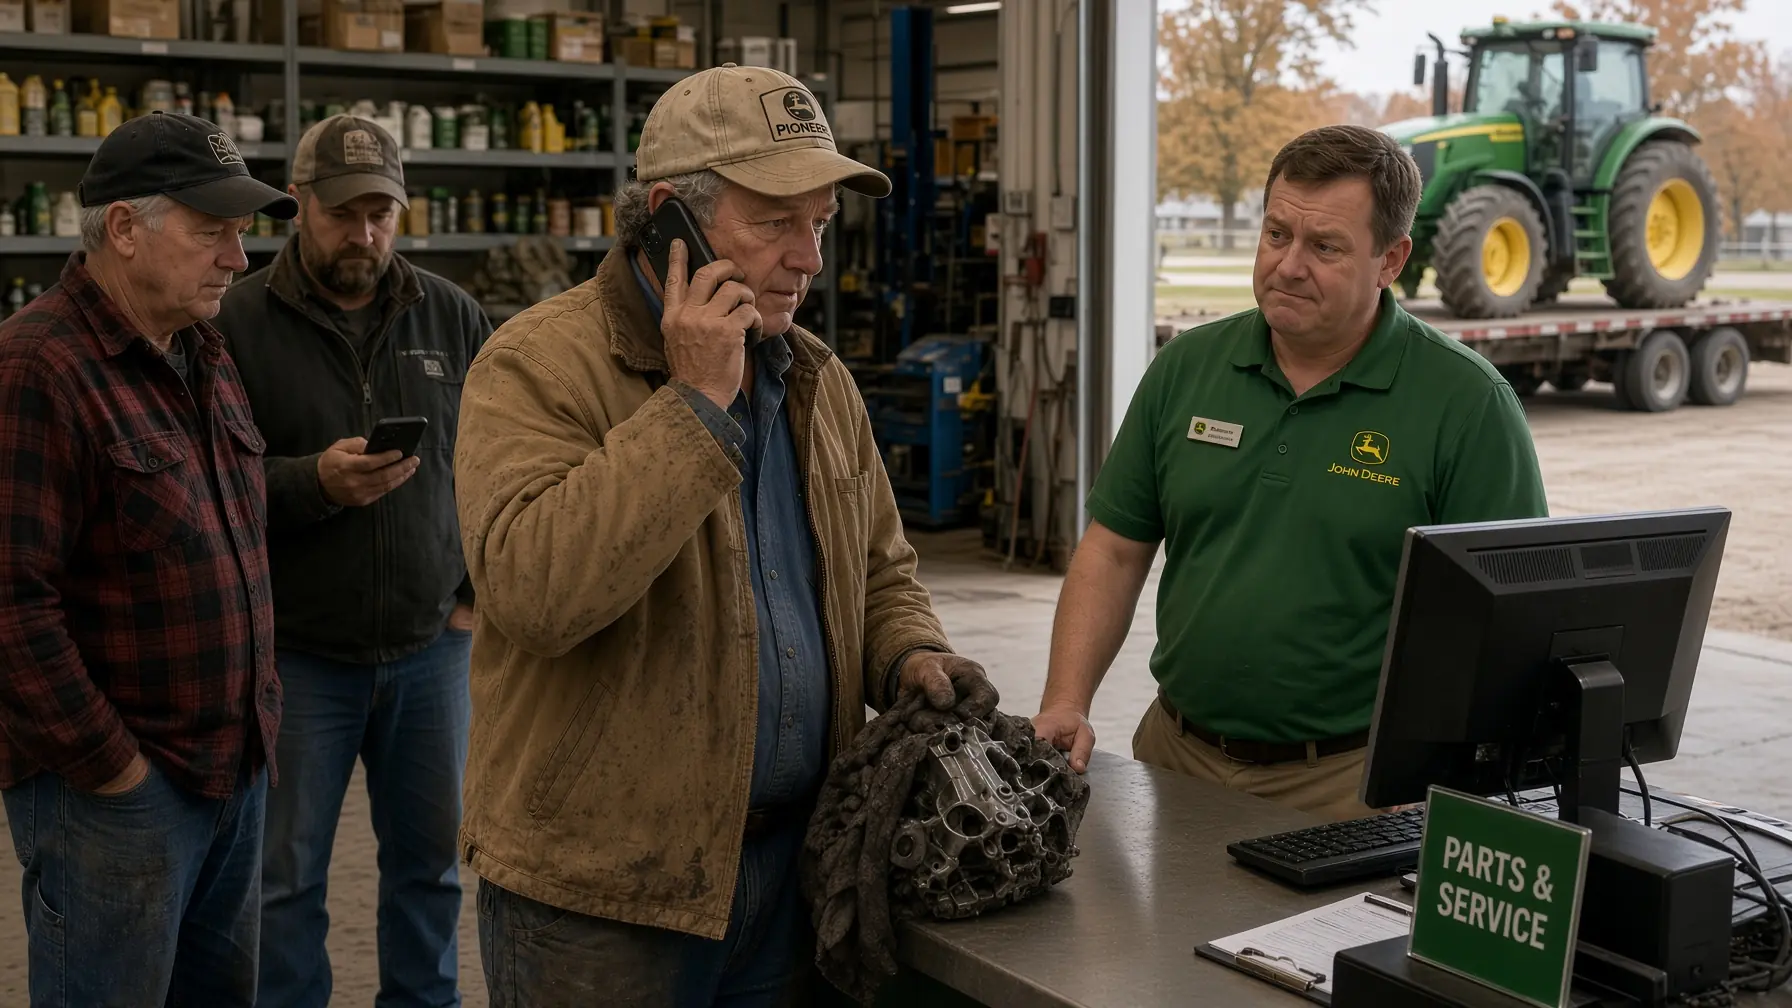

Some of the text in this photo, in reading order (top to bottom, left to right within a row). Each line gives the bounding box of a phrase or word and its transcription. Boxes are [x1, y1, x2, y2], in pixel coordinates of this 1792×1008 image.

[1327, 462, 1400, 486] JOHN DEERE
[1443, 836, 1554, 903] PARTS &
[1437, 881, 1548, 950] SERVICE
